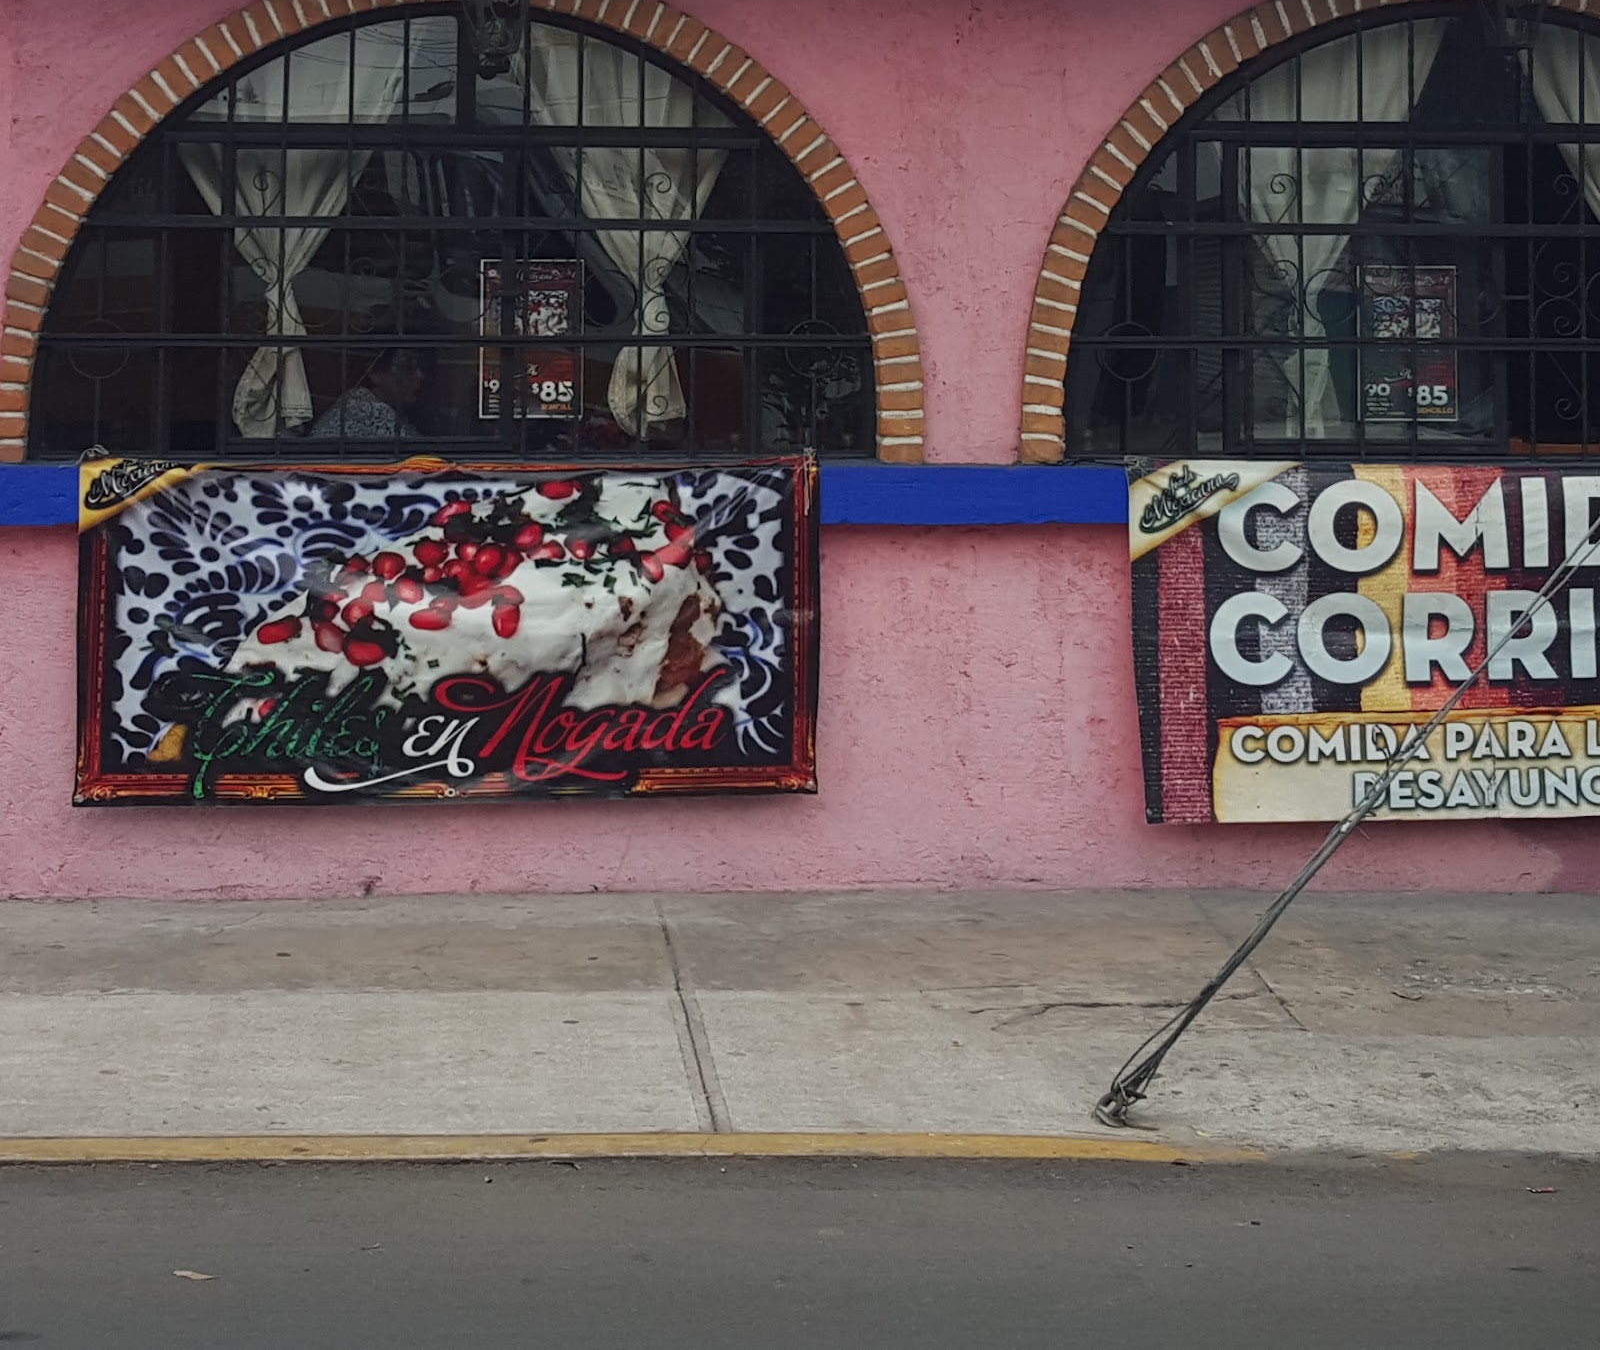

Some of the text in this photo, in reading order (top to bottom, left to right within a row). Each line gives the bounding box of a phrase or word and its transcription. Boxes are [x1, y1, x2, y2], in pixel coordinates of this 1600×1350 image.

[436, 669, 729, 782] Nogada
[1230, 723, 1431, 764] COMIDA
[1446, 721, 1575, 761] PARA
